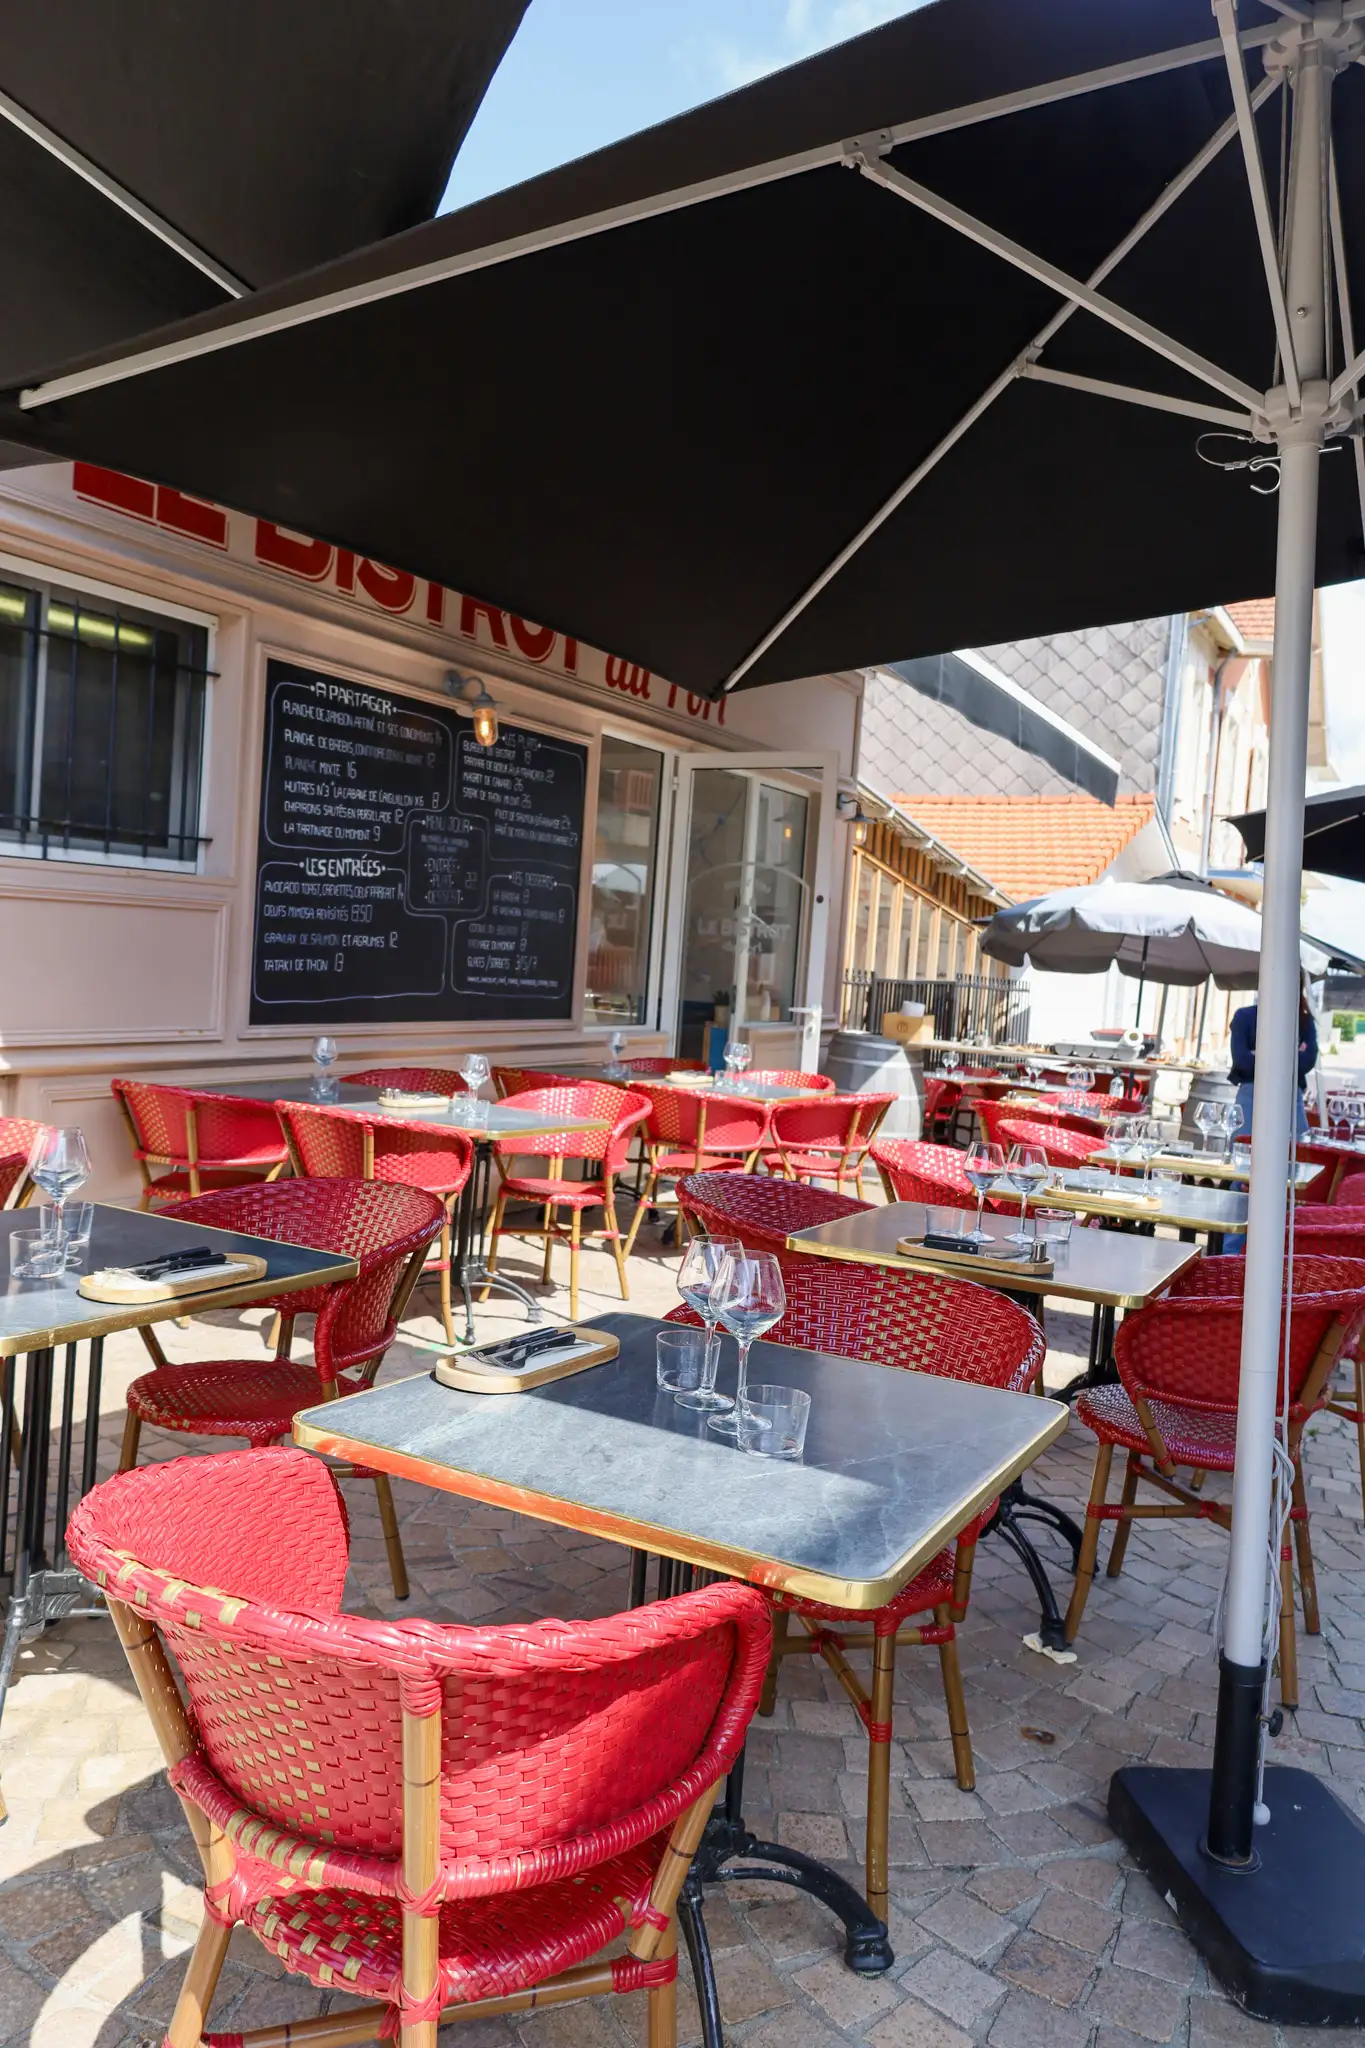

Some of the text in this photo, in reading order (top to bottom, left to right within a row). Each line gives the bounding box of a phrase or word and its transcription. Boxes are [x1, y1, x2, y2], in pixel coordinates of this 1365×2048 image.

[329, 685, 392, 716] PARTAGER
[283, 700, 314, 719] PLANCHE
[316, 707, 325, 722] DE
[325, 709, 353, 728] JAMBON
[284, 729, 315, 747] PLANCHE
[318, 736, 327, 749] DE
[319, 761, 341, 777] MIXTE
[347, 760, 357, 780] 16
[284, 822, 294, 834] LA
[306, 853, 381, 878] LES ENTRÉES
[264, 881, 300, 894] AVOCADO
[287, 905, 315, 919] MIMOSA
[341, 934, 351, 948] ET
[352, 935, 385, 948] AGRUMES
[263, 959, 293, 972] TATAKI
[294, 959, 304, 972] DE
[305, 959, 329, 972] THON
